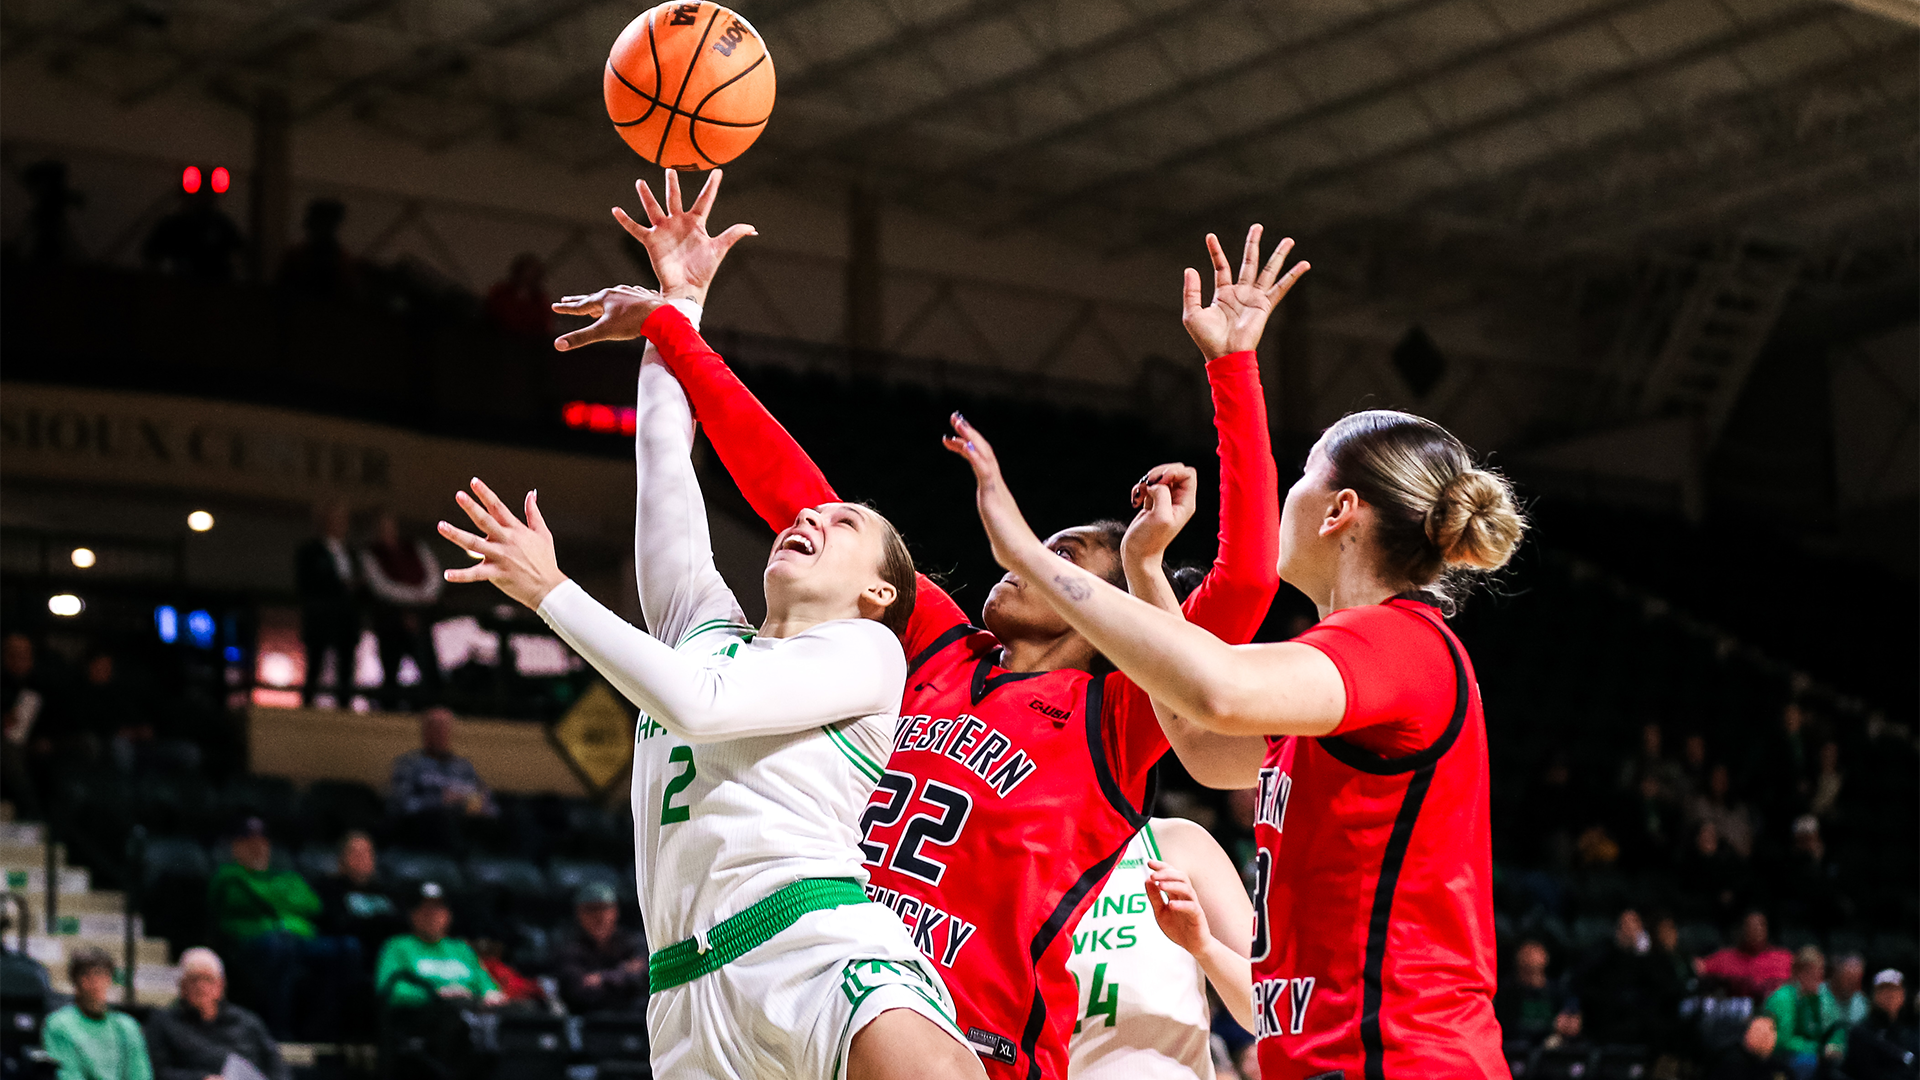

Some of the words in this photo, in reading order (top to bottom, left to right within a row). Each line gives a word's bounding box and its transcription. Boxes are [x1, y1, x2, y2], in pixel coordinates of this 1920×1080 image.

[661, 746, 696, 826] 2
[859, 769, 973, 887] 22
[1073, 963, 1119, 1034] 4
[999, 1043, 1012, 1057] XL
